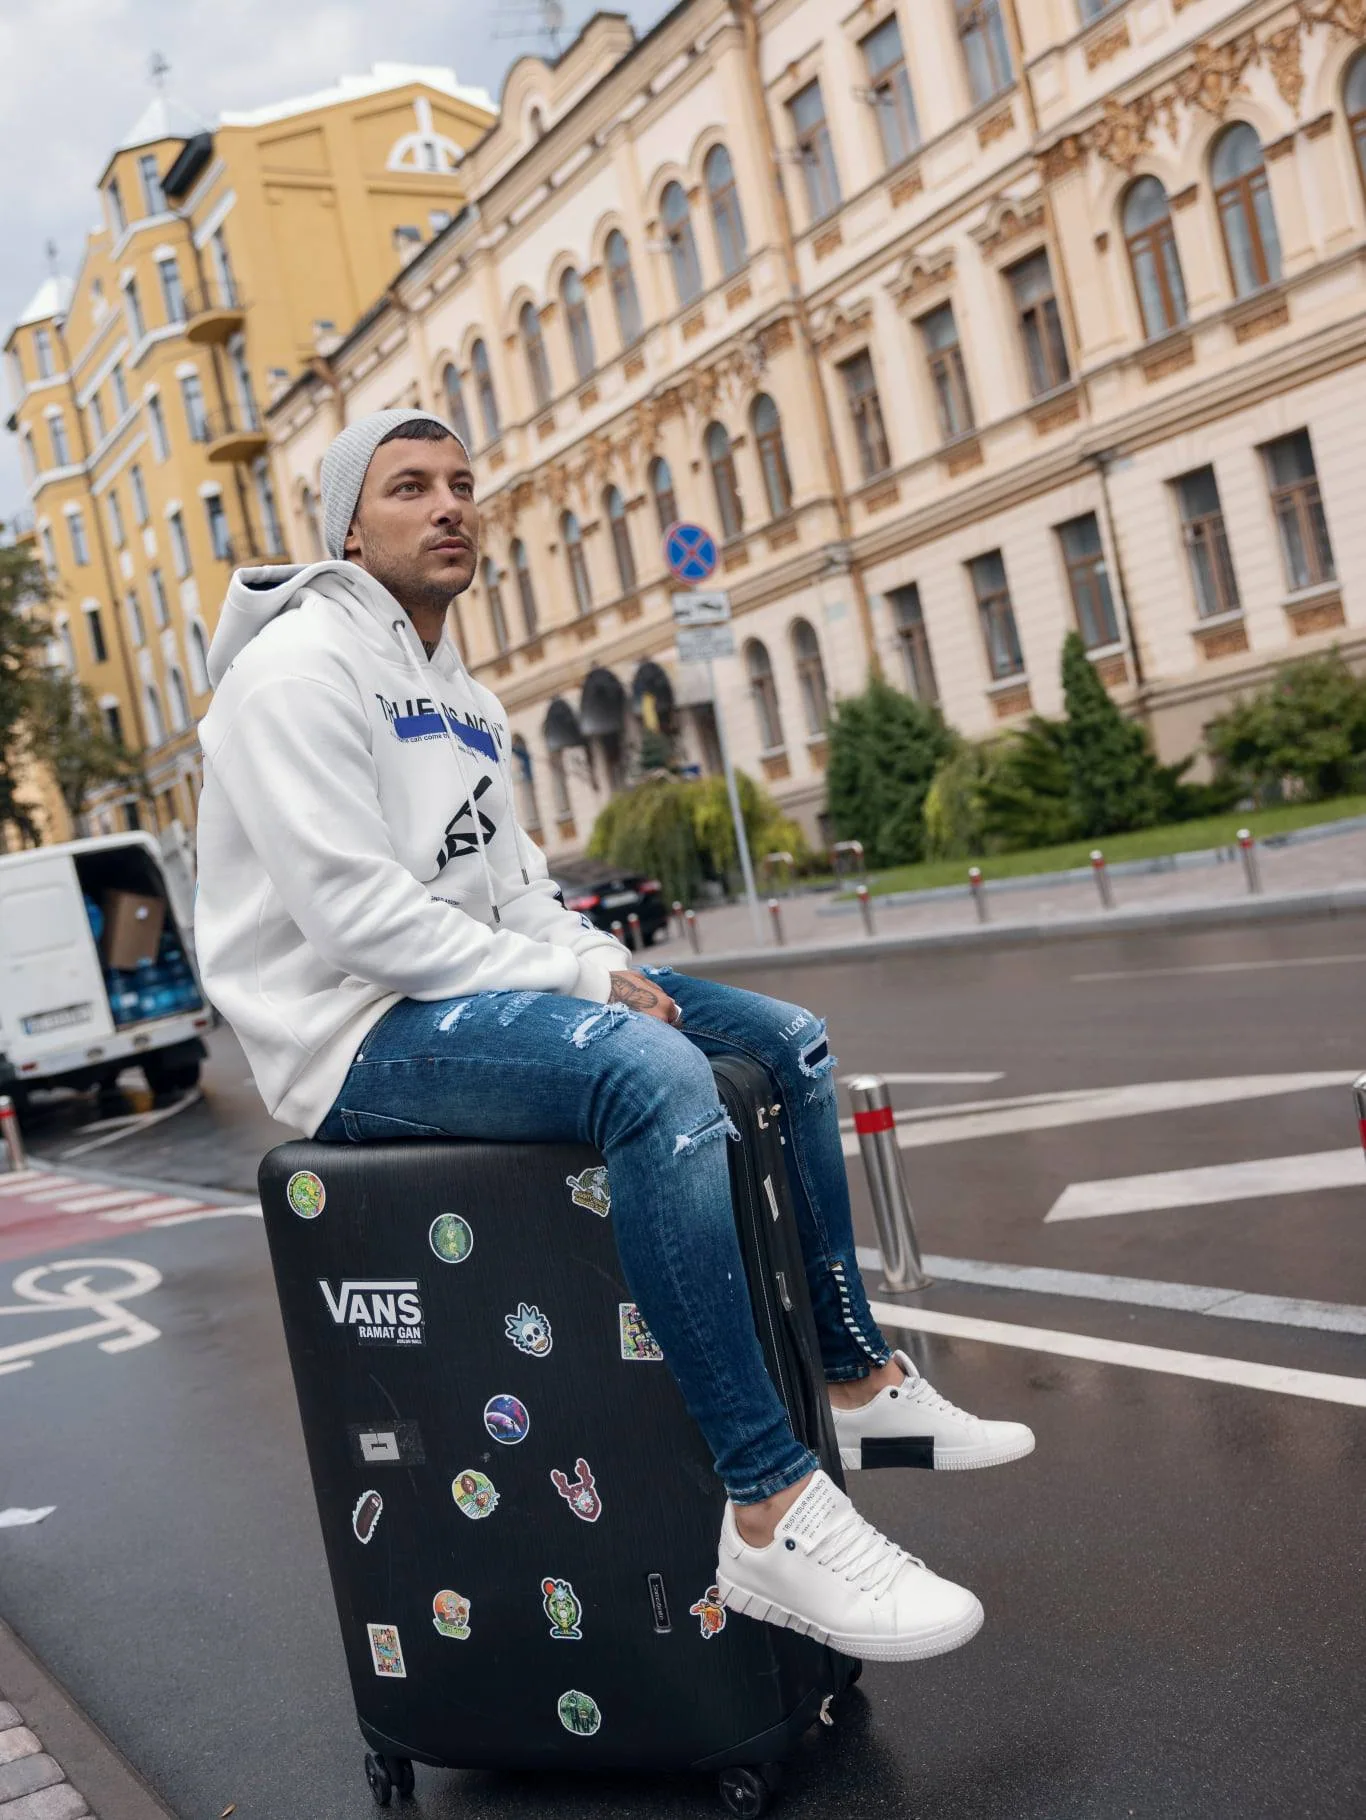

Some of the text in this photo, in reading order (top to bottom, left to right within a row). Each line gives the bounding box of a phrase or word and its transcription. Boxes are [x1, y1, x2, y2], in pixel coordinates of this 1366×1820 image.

[319, 1280, 421, 1325] VANS
[359, 1326, 421, 1339] RAMAT GAN
[782, 1515, 796, 1532] TRUST
[795, 1500, 808, 1516] YOUR
